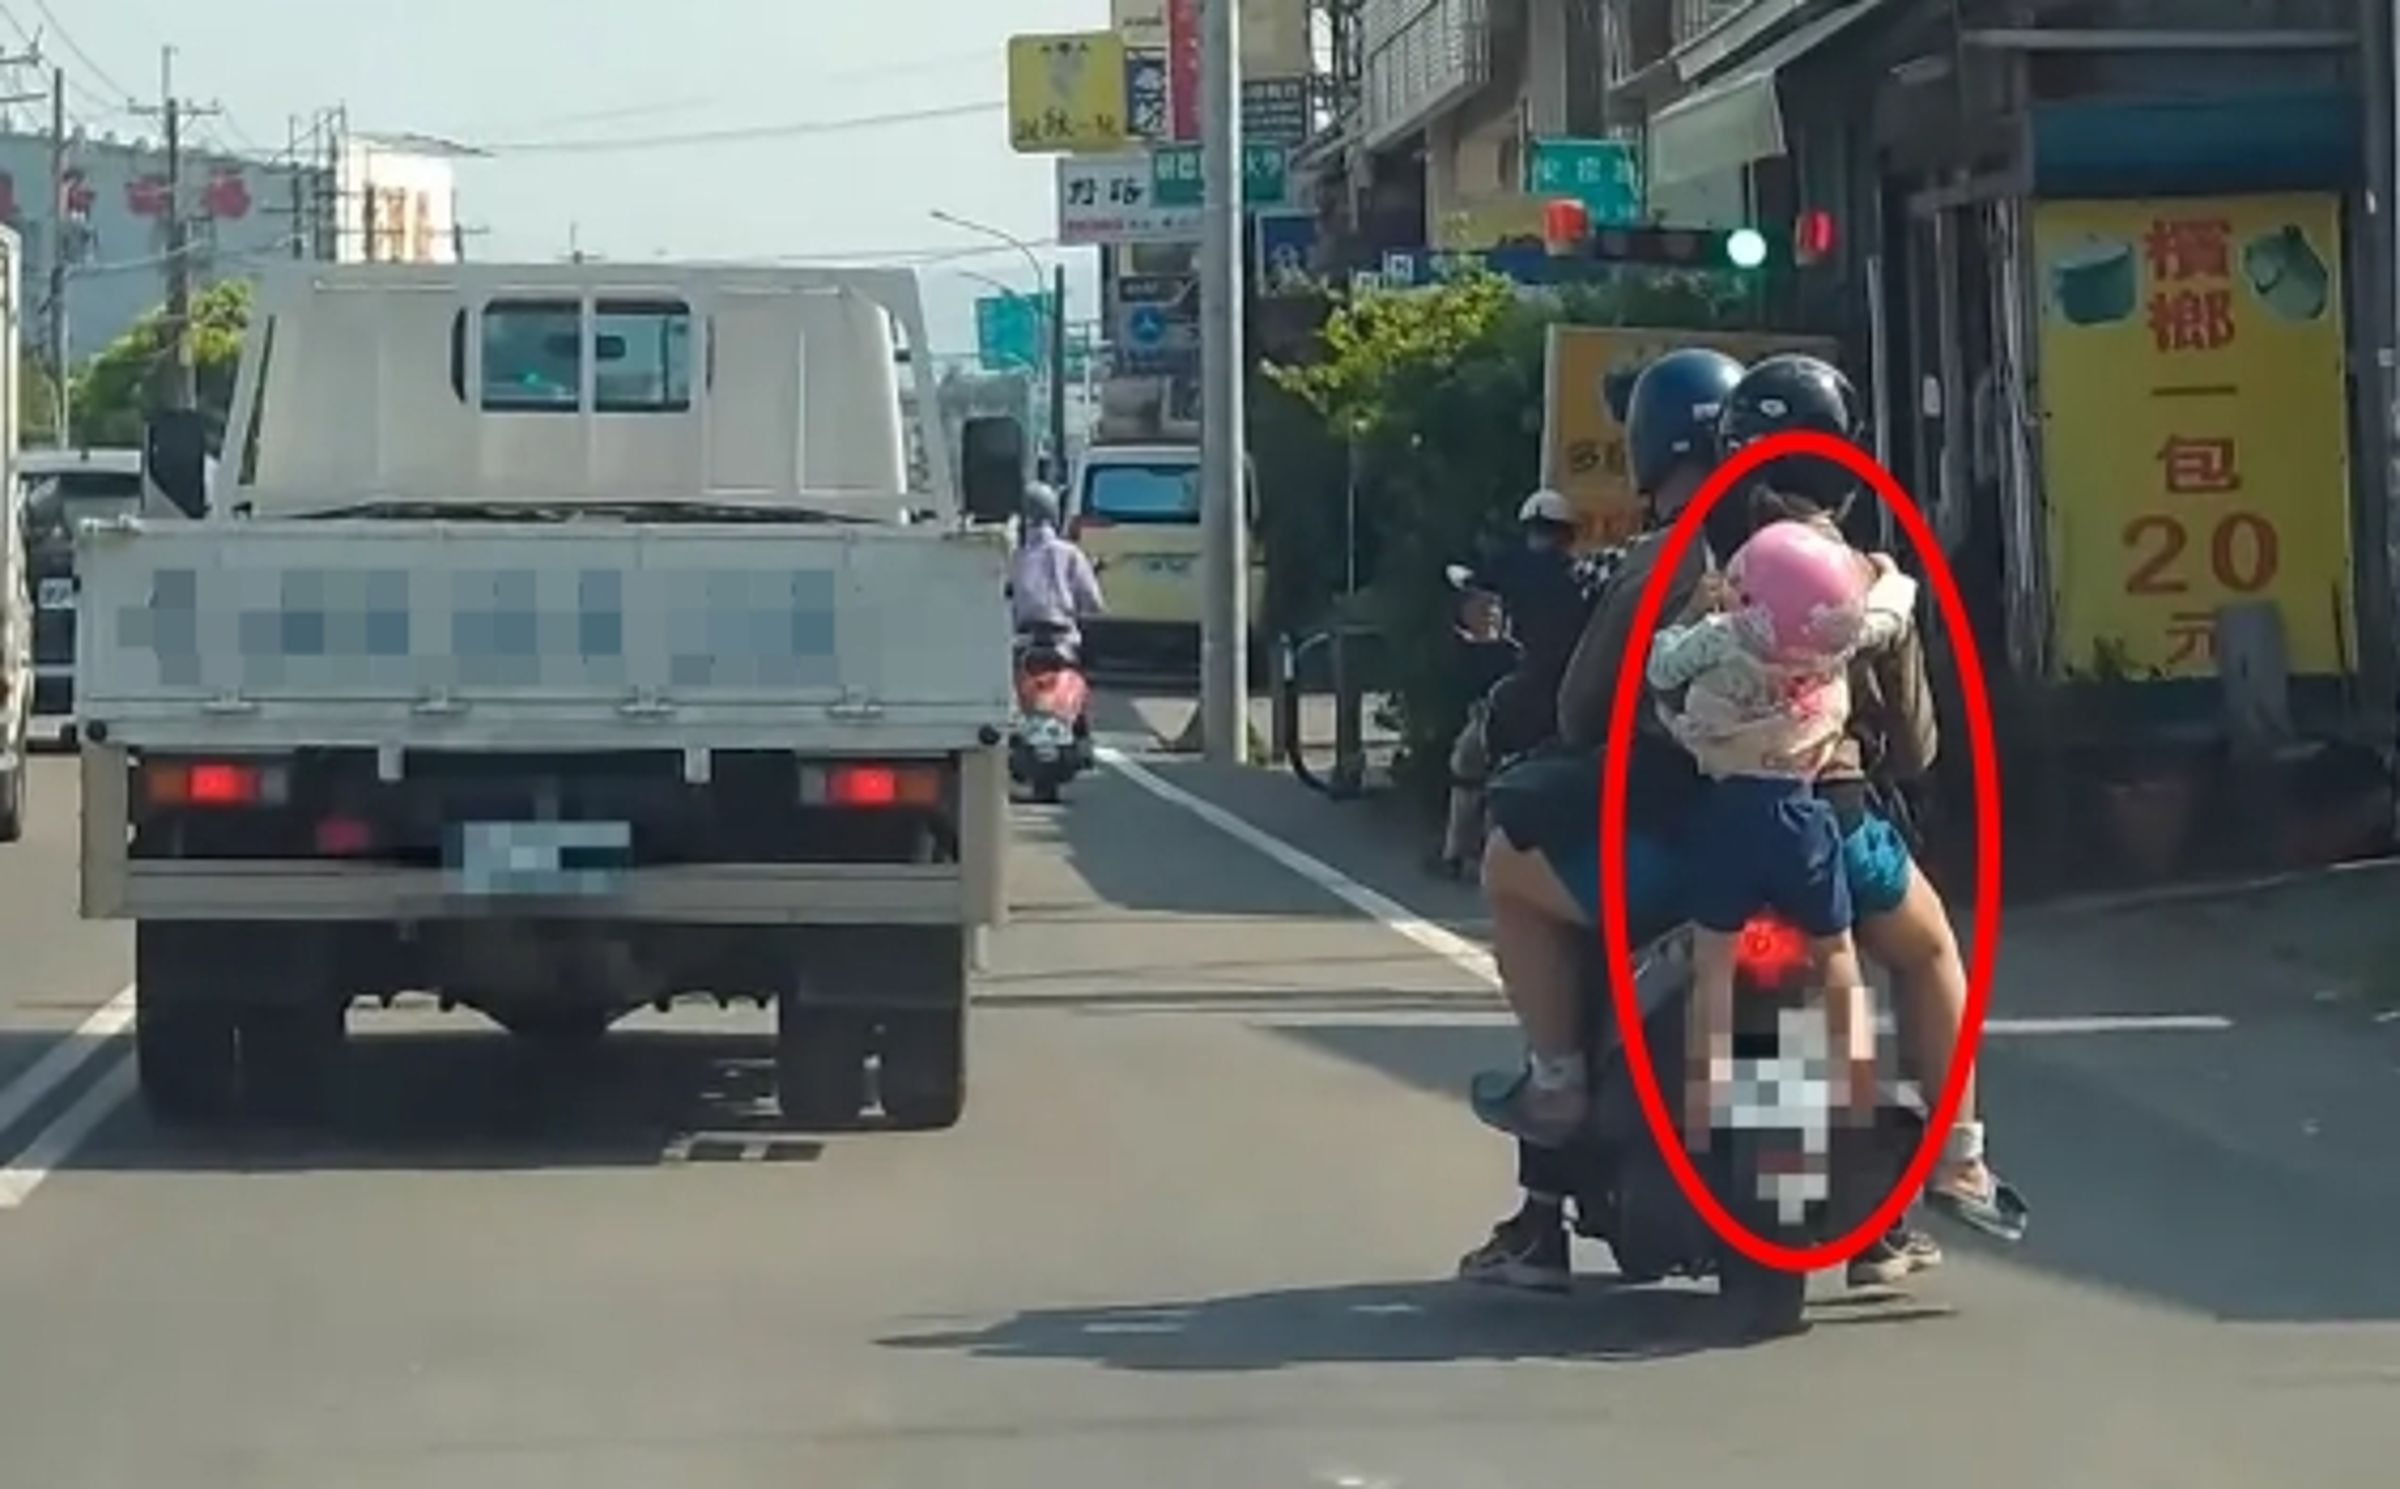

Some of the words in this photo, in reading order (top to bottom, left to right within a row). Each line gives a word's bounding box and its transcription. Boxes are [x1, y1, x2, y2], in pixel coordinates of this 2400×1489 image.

[2123, 219, 2279, 665] 檳榔一包20元
